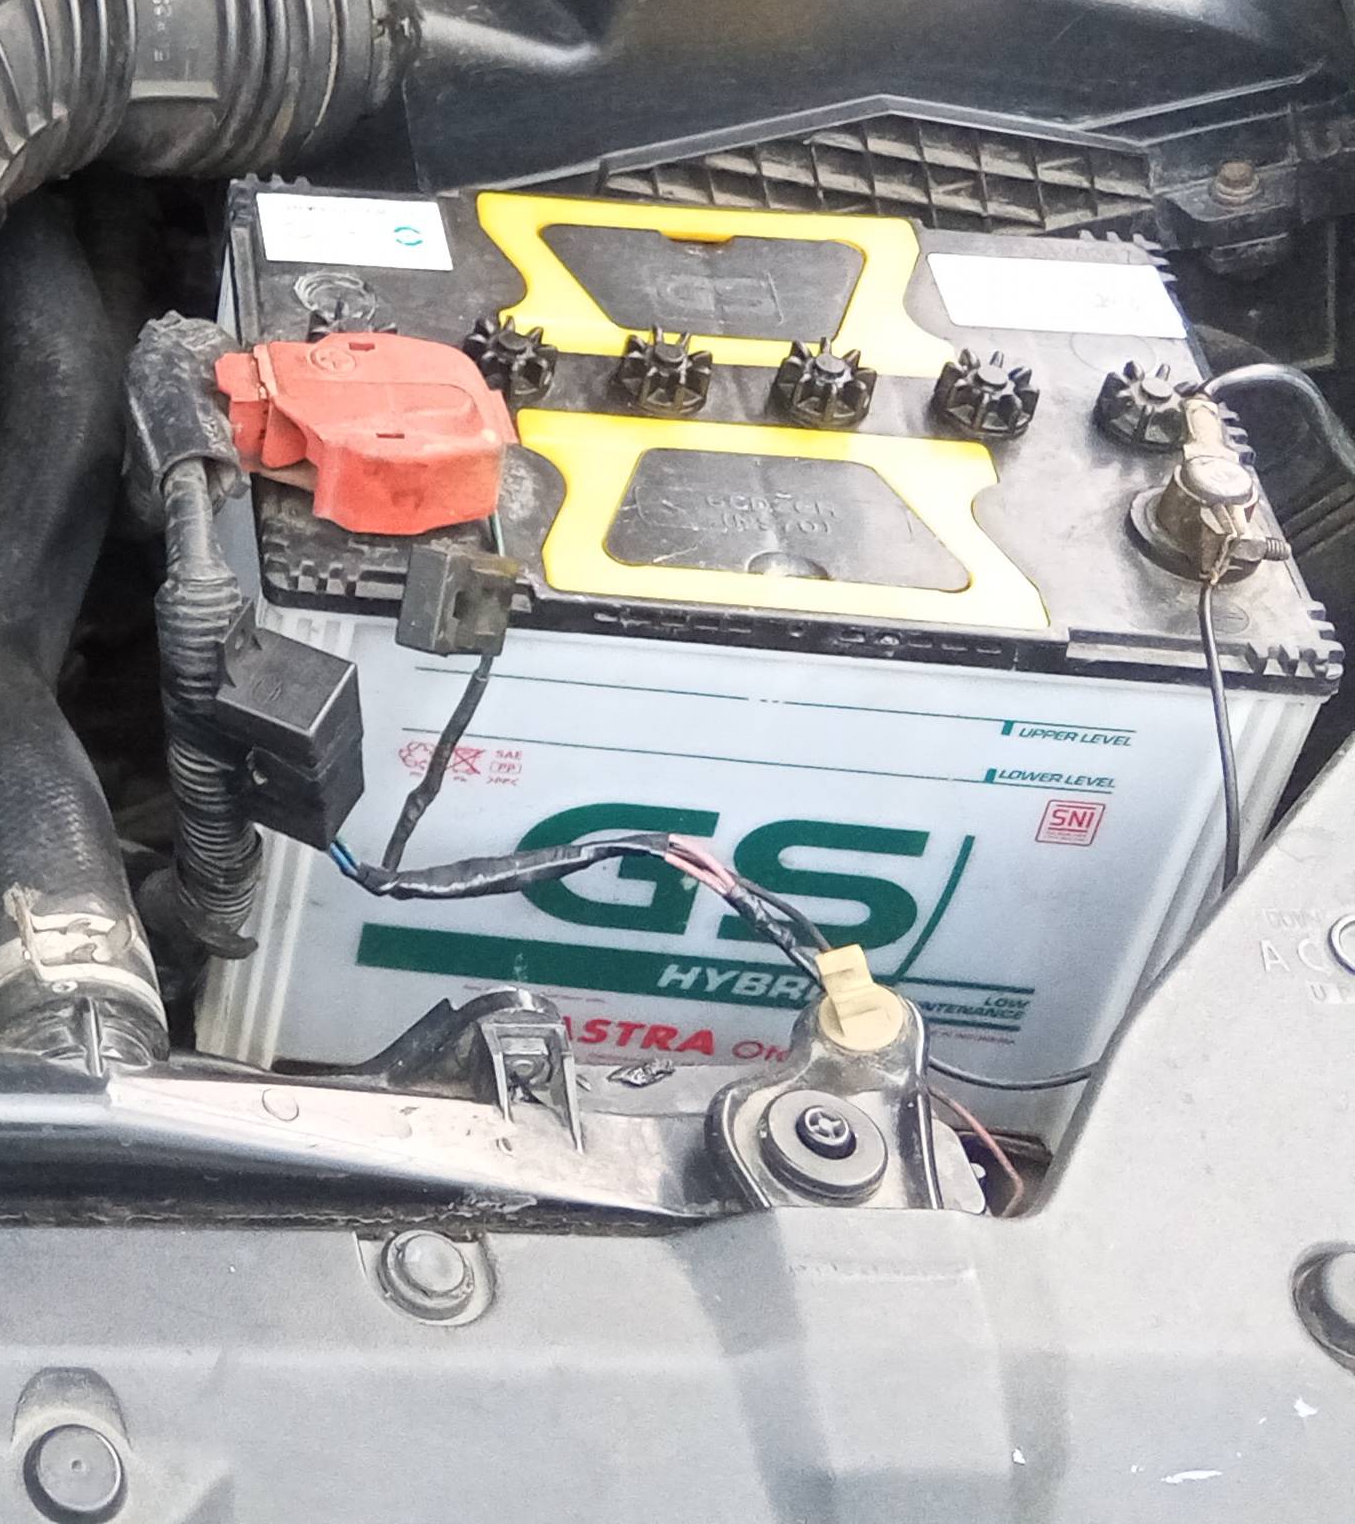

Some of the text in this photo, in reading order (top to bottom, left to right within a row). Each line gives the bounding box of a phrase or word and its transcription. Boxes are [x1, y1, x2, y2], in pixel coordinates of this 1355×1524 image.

[1019, 727, 1133, 747] UPPER LEVEL
[998, 768, 1116, 789] LOWER LEVEL
[1049, 808, 1096, 830] SNI
[514, 802, 932, 952] GS
[656, 963, 826, 1001] HYBRI
